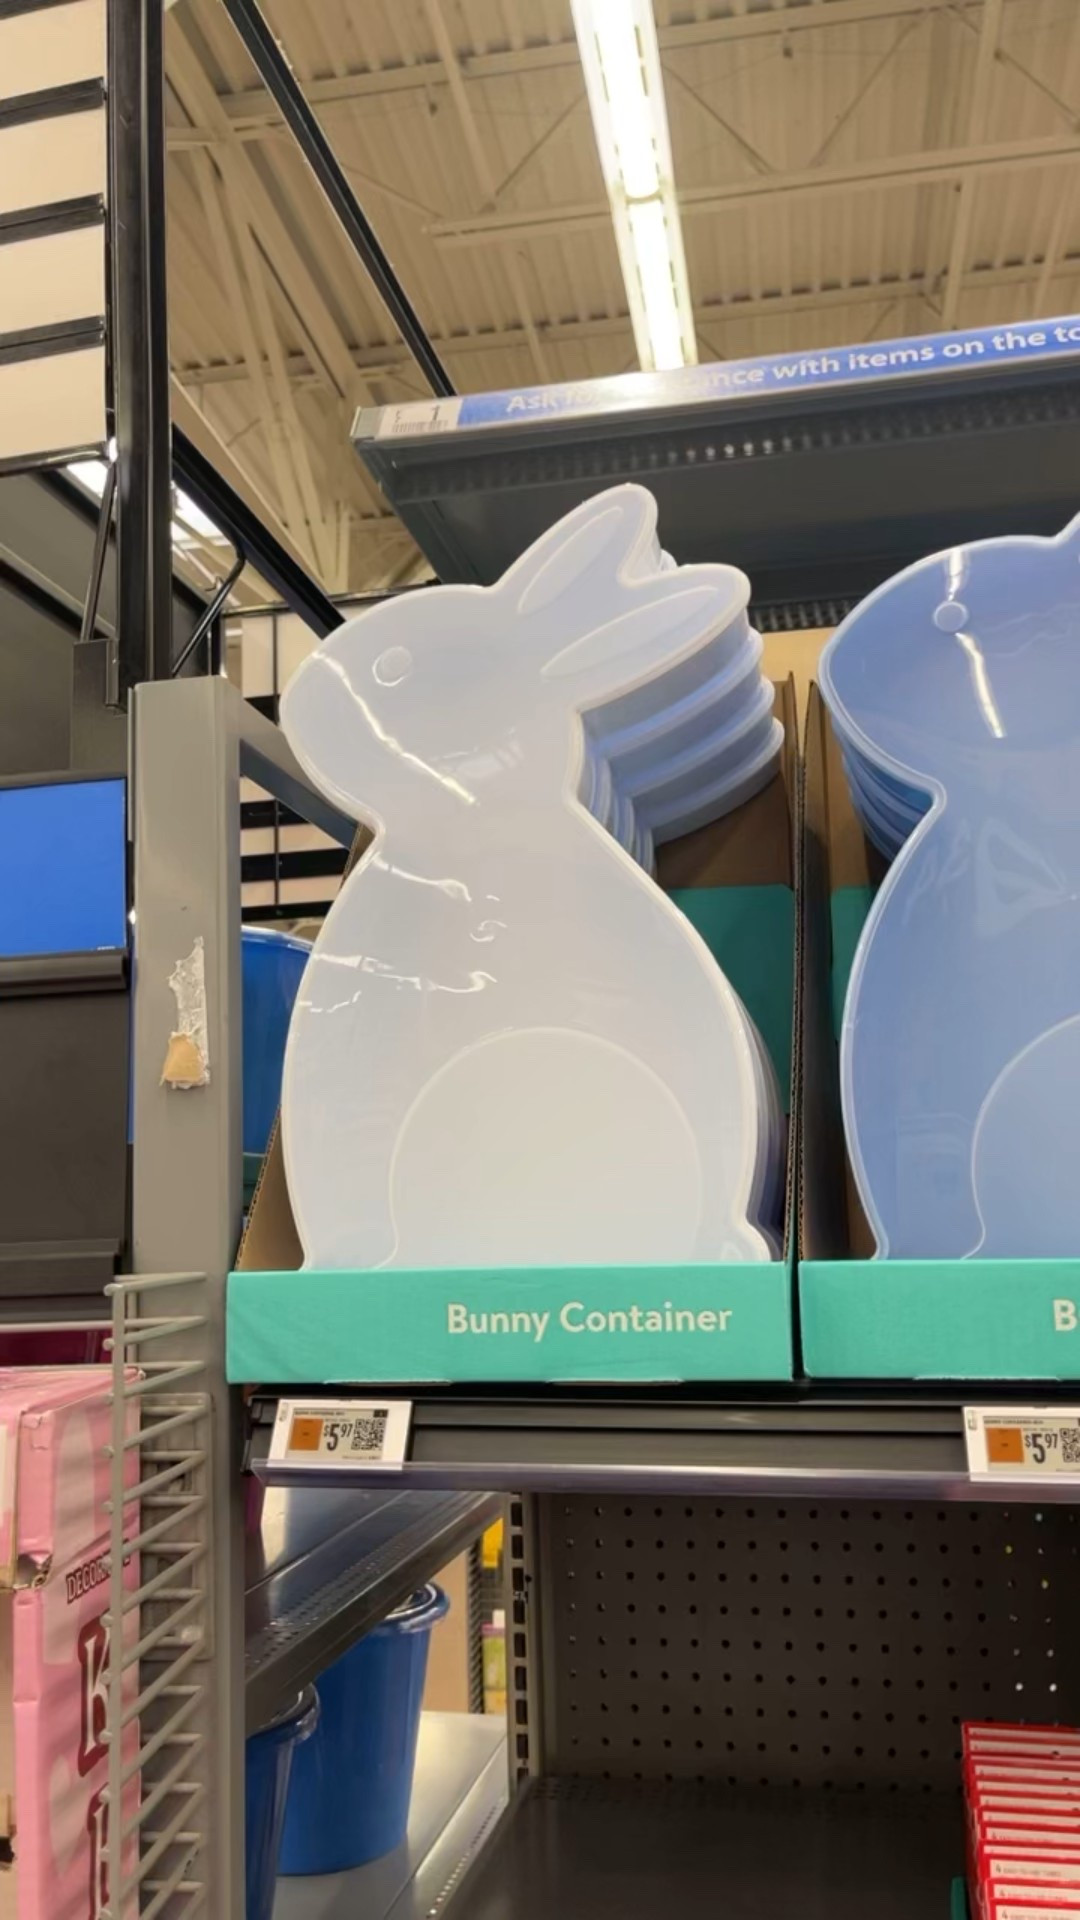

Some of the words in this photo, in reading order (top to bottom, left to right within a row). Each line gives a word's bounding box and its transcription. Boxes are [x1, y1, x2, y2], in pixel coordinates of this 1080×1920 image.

[506, 393, 558, 412] Ask
[773, 356, 840, 379] with
[849, 346, 935, 370] items
[943, 340, 984, 357] on
[992, 332, 1046, 351] the
[447, 1303, 549, 1342] Bunny
[559, 1301, 732, 1332] Container
